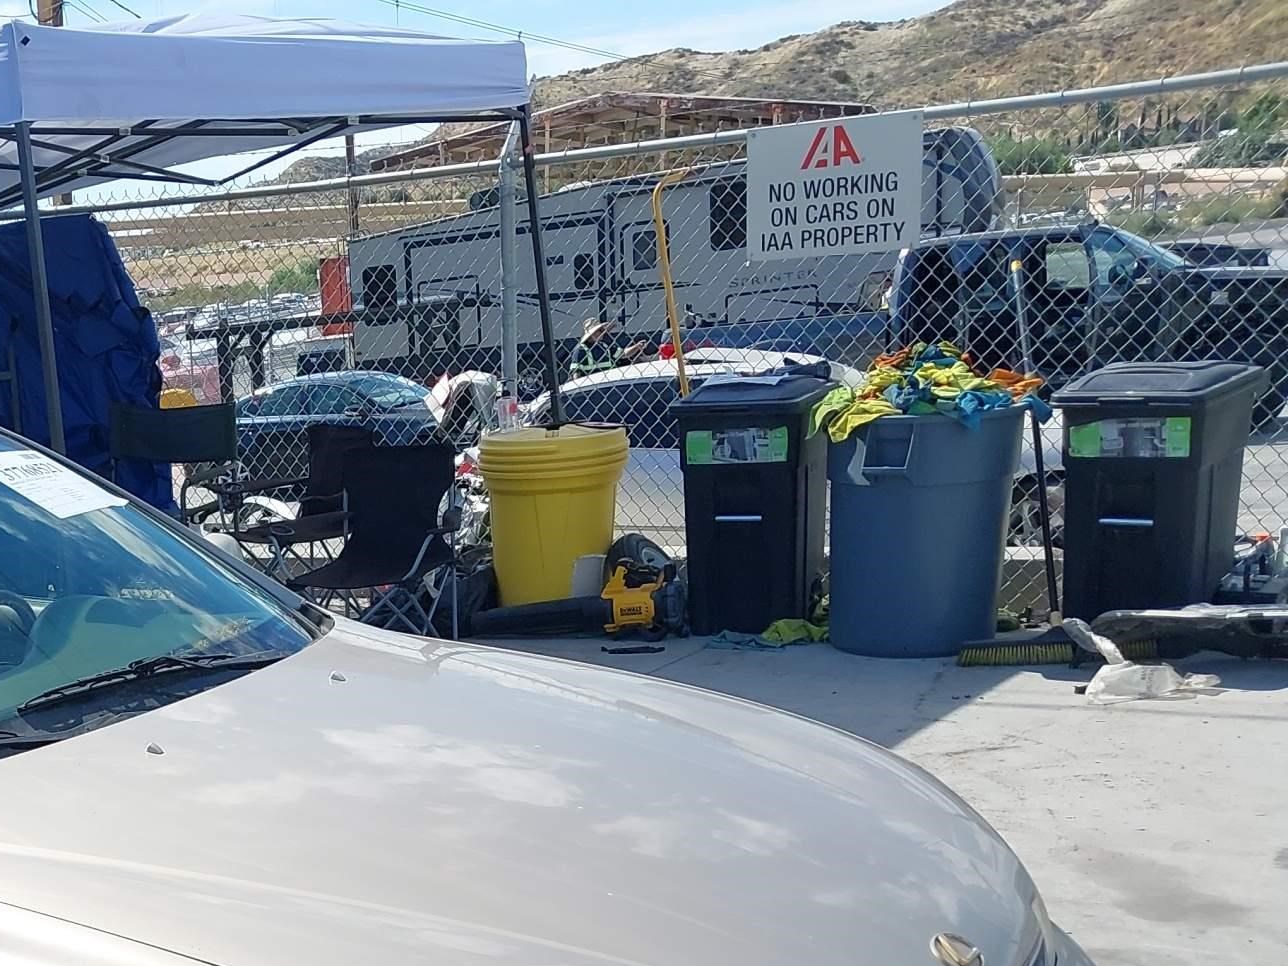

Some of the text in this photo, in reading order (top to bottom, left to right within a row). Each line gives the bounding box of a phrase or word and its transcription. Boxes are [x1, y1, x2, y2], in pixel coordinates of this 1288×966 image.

[769, 171, 898, 203] NO WORKING
[771, 197, 895, 227] ON CARS ON
[761, 221, 906, 252] IAA PROPERTY
[729, 268, 818, 288] SPRINTER
